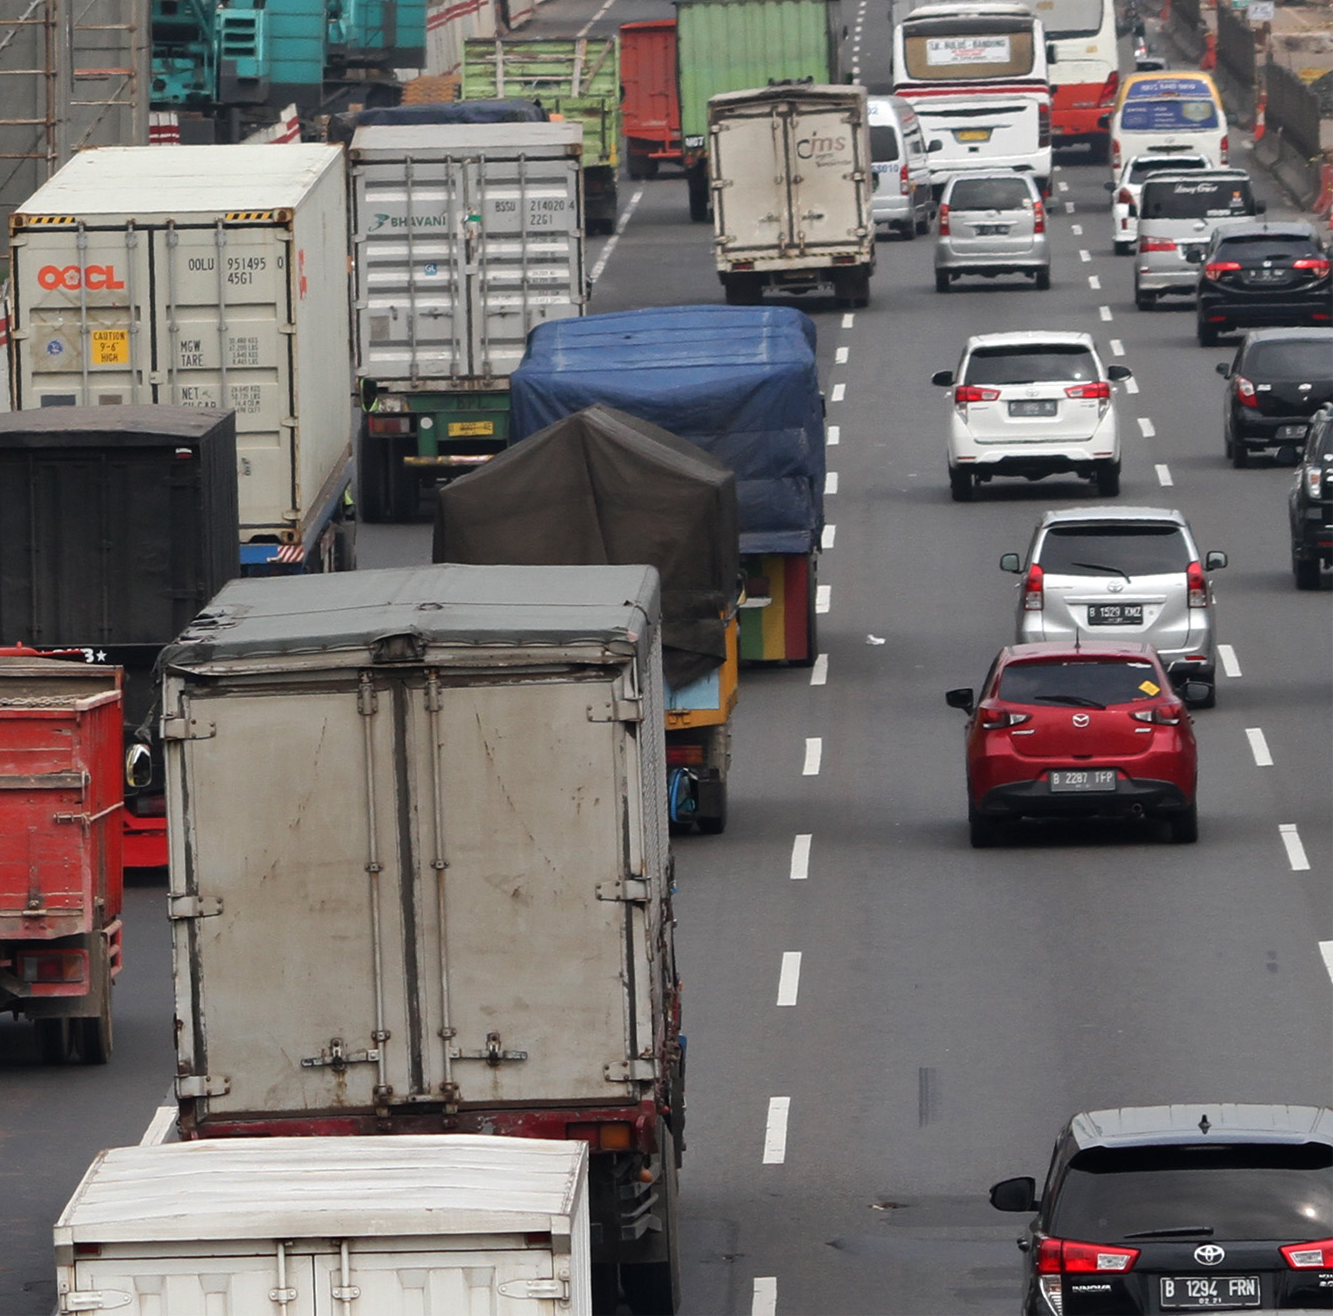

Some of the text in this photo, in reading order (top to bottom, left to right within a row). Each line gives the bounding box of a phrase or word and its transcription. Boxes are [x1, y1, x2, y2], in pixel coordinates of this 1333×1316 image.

[530, 200, 565, 211] 214020
[391, 216, 447, 228] BHAVANI
[227, 257, 267, 271] 951495
[37, 265, 125, 290] OOCL
[227, 272, 253, 285] 45G1
[93, 332, 126, 341] CAUTION
[101, 353, 118, 363] HIGH
[1089, 606, 1095, 617] B
[1100, 607, 1121, 618] 1529
[1053, 771, 1113, 785] B 2287 TFP
[1072, 1284, 1112, 1292] INNOVA
[1165, 1278, 1255, 1298] B 1294 FRN
